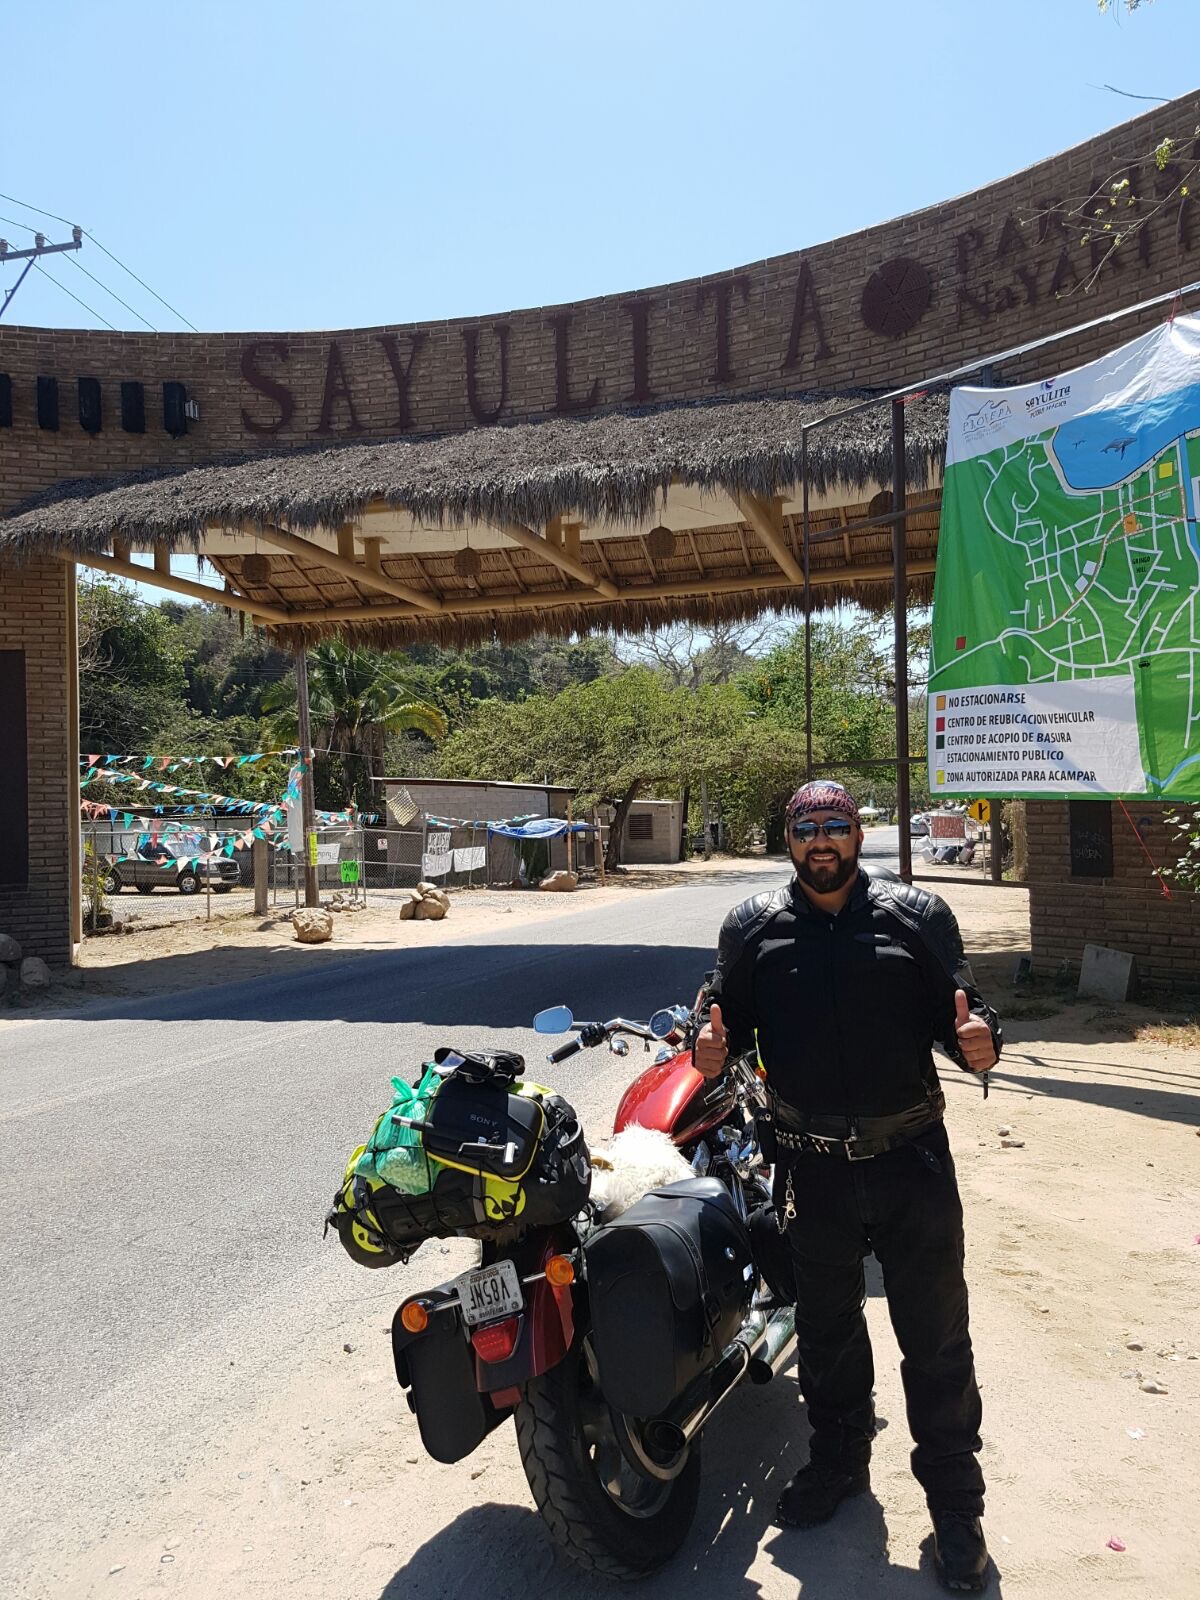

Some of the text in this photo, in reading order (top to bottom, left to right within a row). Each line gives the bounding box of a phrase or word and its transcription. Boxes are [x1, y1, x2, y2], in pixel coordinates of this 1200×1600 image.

[240, 260, 834, 435] SAYULITA
[949, 693, 1026, 708] NO ESTACIONARSE
[948, 711, 1095, 728] CENTRO DE REUBICACION VEHICULAR
[947, 732, 1072, 746] CENTRO DE ACOPIO DE BASURA
[947, 750, 1064, 763] ESTACIONAMIENTO PUBLICO
[947, 770, 1097, 782] ZONA AUTORIZADA PARA ACAMPAR
[470, 1114, 498, 1127] SONY
[469, 1276, 511, 1310] V85NF
